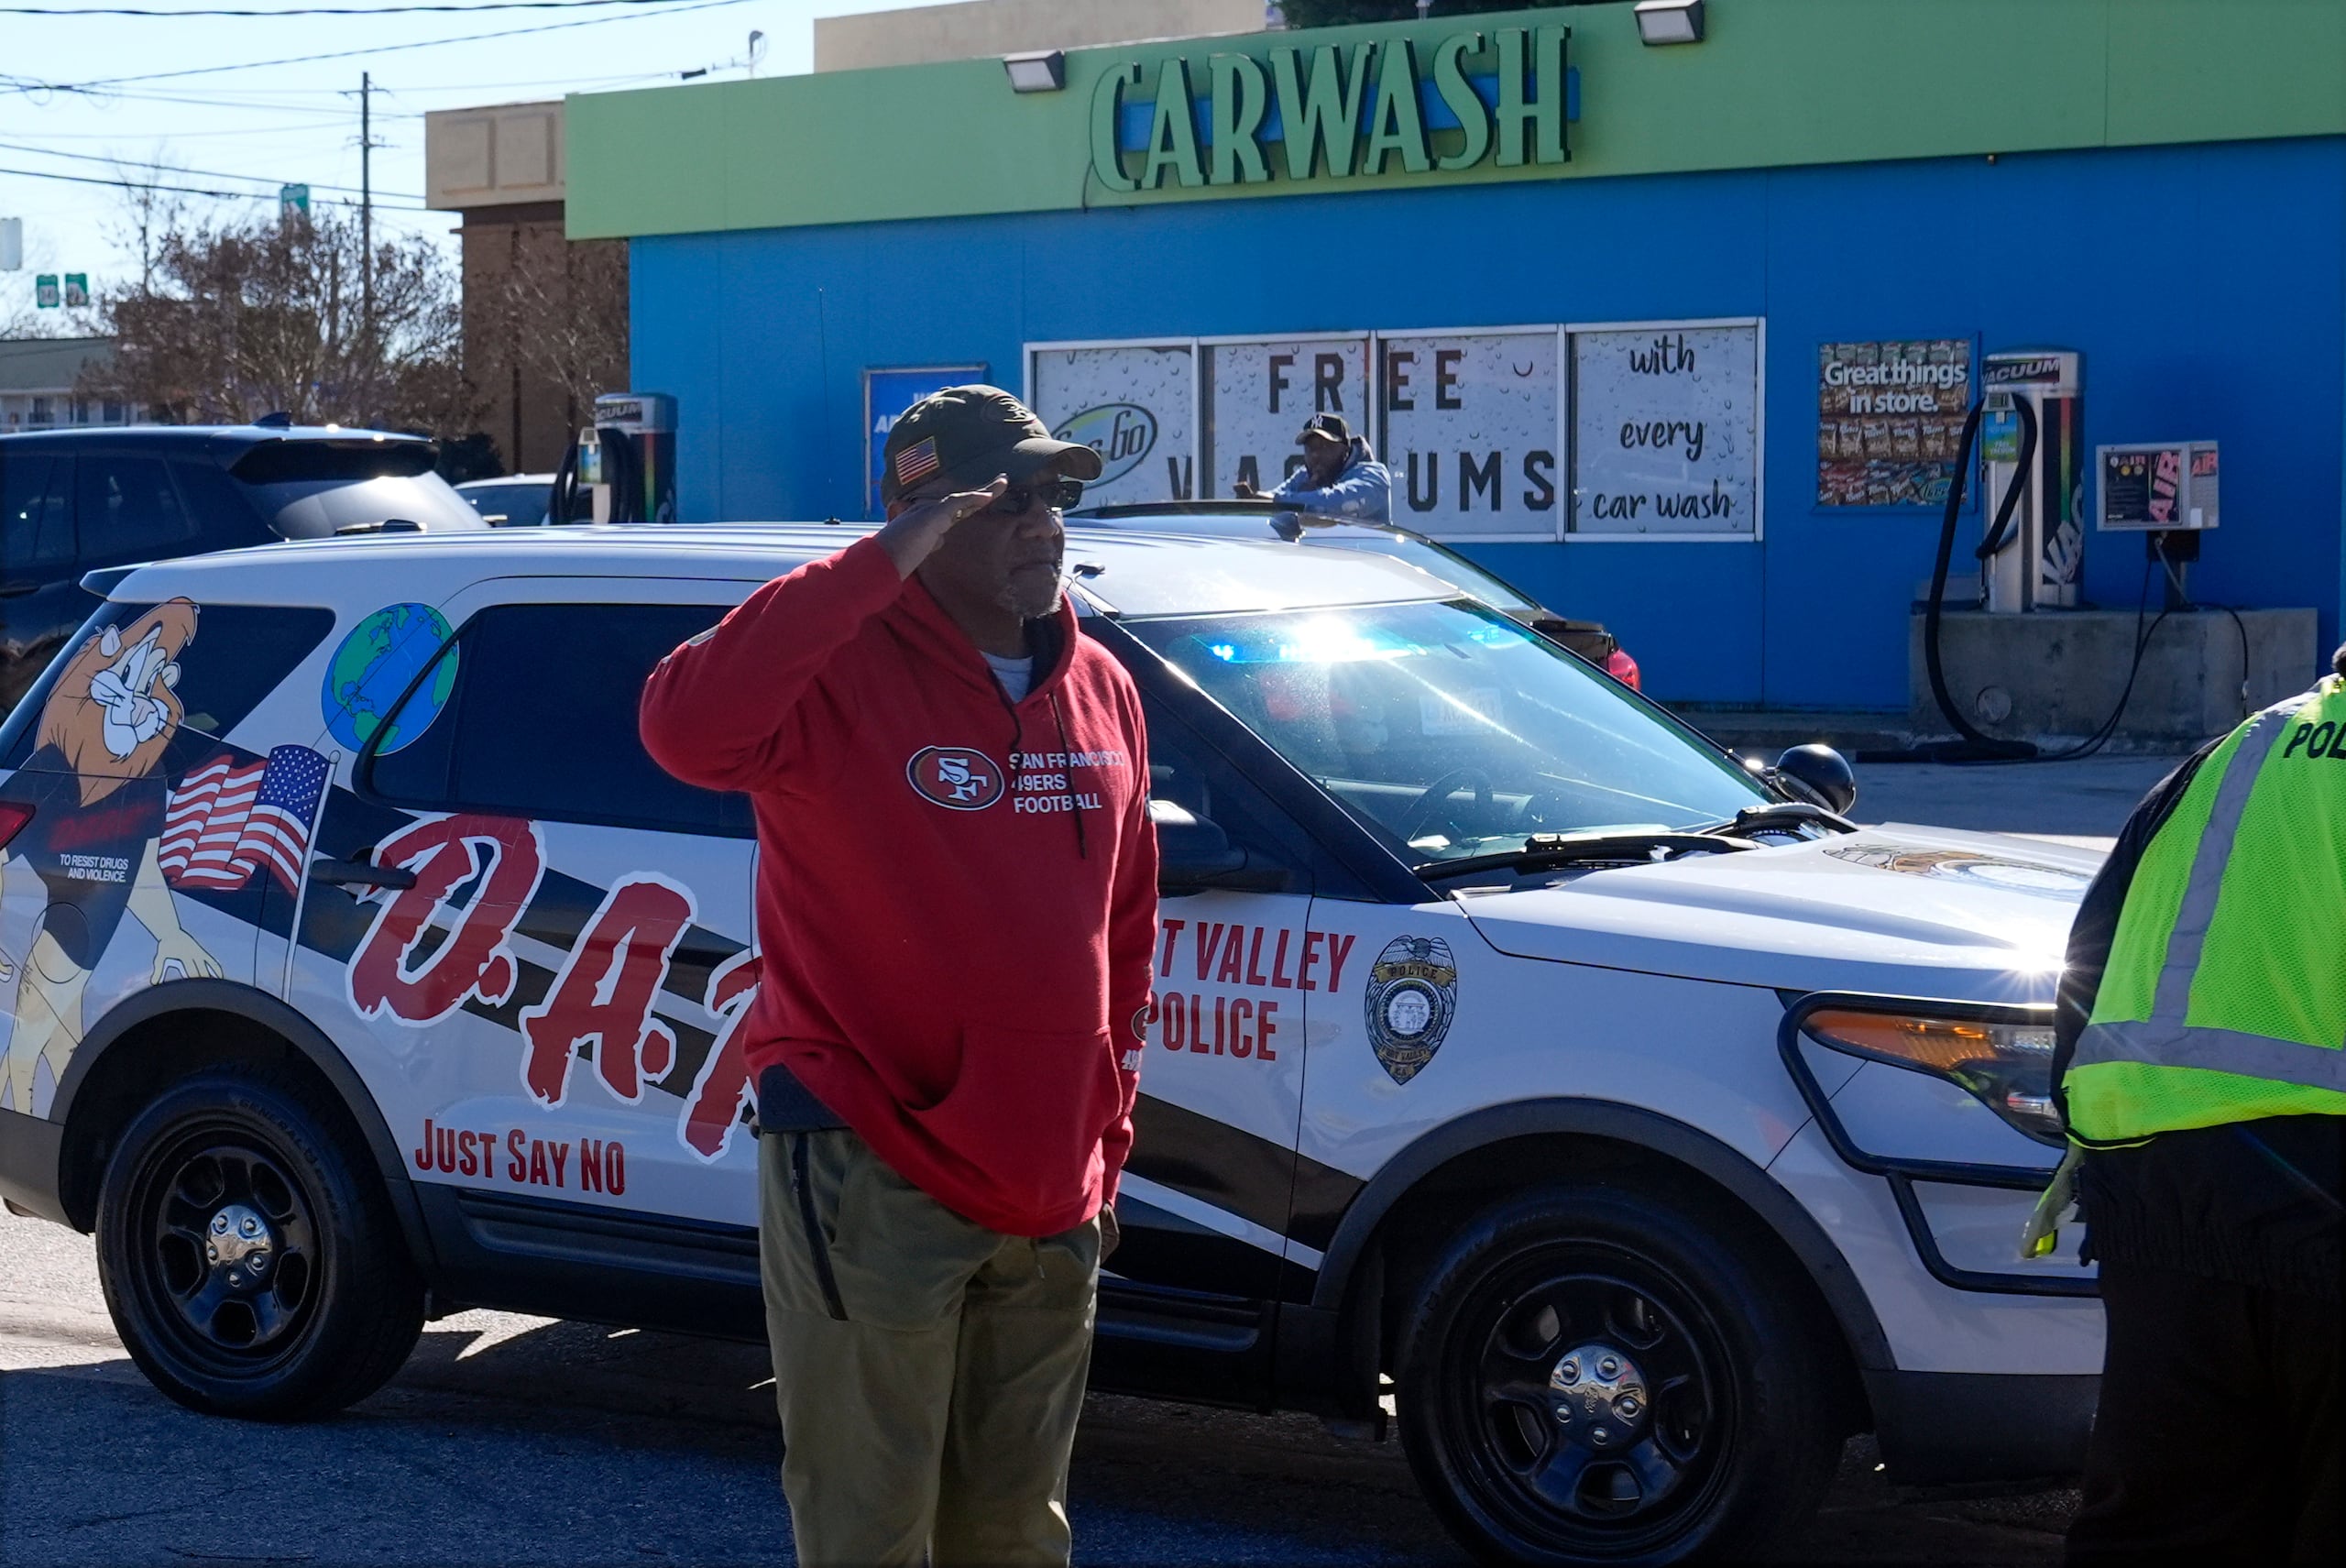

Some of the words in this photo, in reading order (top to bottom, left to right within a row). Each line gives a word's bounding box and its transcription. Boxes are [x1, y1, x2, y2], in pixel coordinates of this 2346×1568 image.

[1090, 24, 1572, 192] CARWASH
[1630, 334, 1695, 375] with
[1268, 349, 1463, 414] FREE
[1825, 360, 1888, 386] Great
[1893, 356, 1967, 389] things
[1980, 358, 2060, 385] VACUUM
[596, 403, 640, 422] CUUM
[1849, 391, 1872, 413] in
[1874, 390, 1939, 412] store.
[1110, 410, 1146, 461] Go
[1620, 421, 1704, 461] every
[2191, 452, 2218, 477] AIR
[1593, 491, 1647, 520] car
[1657, 478, 1731, 520] wash
[1009, 751, 1045, 770] SAN
[1047, 750, 1125, 769] FRANCISCO
[1011, 773, 1067, 792] 49ERS
[1013, 793, 1102, 813] FOOTBALL
[60, 853, 71, 866] TO
[71, 855, 100, 870] RESIST
[100, 857, 129, 871] DRUGS
[68, 868, 85, 880] AND
[1197, 921, 1356, 993] VALLEY
[1390, 965, 1438, 980] POLICE
[1146, 990, 1279, 1061] POLICE
[580, 1137, 626, 1196] NO
